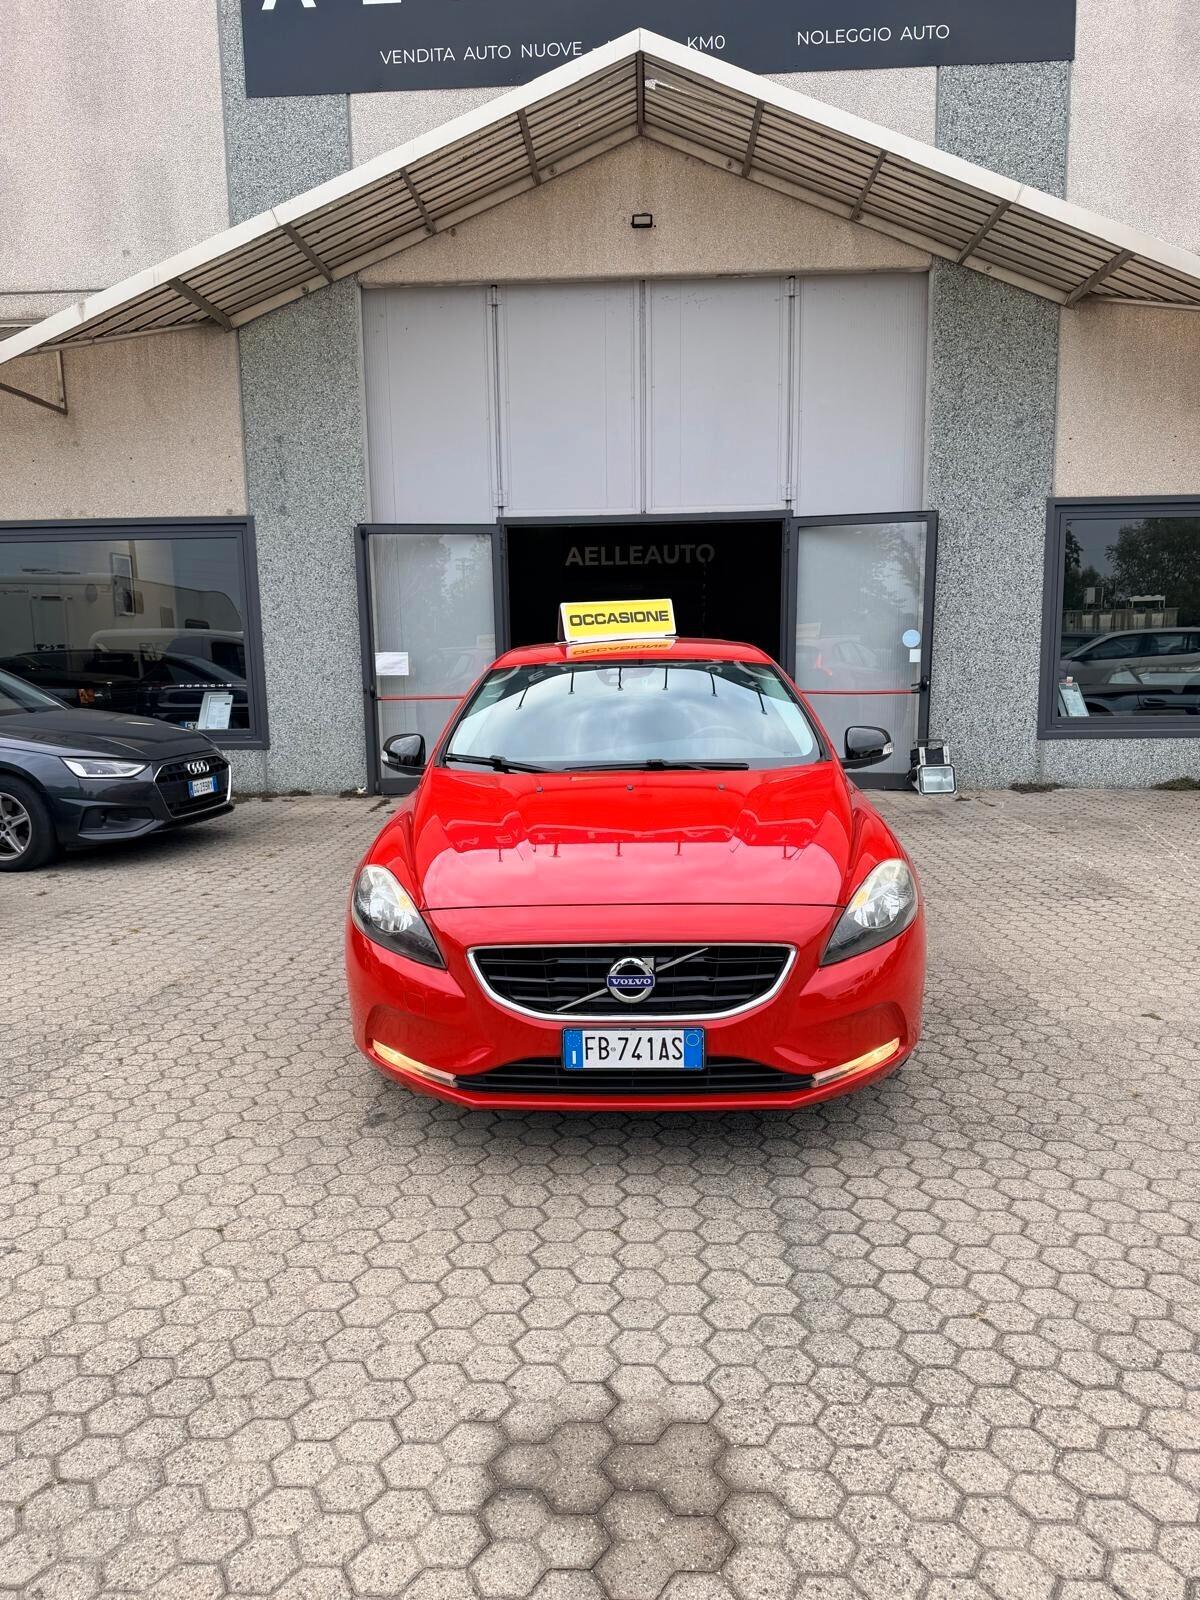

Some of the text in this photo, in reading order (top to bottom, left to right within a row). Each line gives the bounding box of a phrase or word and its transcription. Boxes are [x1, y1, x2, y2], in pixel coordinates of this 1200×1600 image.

[797, 24, 950, 46] NOLEGGIO AUTO
[380, 47, 455, 64] VENDITA
[463, 44, 511, 61] AUTO
[521, 41, 582, 58] NUOVE
[564, 543, 716, 567] AELLEAUTO
[569, 610, 670, 627] OCCASIONE
[610, 977, 652, 986] VOLVO
